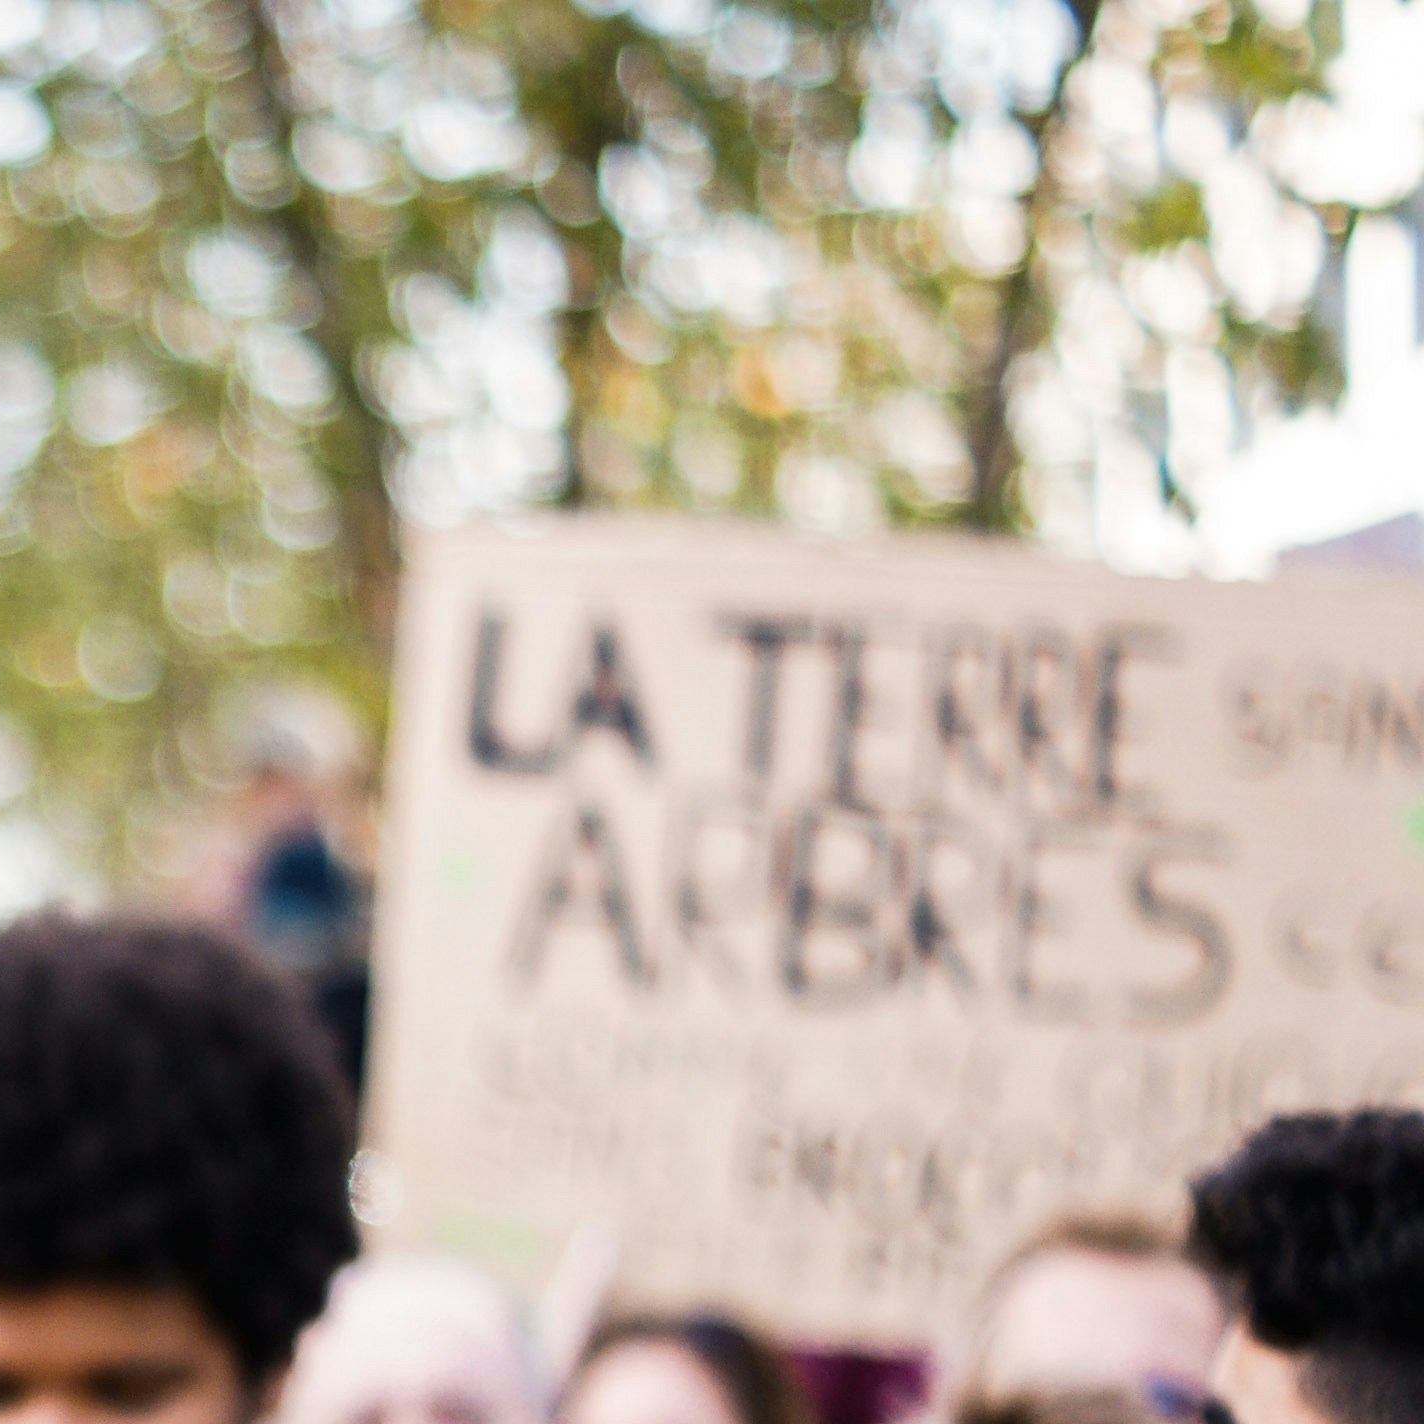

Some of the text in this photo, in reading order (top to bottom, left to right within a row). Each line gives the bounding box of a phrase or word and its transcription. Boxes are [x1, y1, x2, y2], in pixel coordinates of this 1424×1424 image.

[464, 600, 660, 776] LA
[712, 608, 1188, 820] TERRE
[502, 795, 1236, 1024] ARBRES
